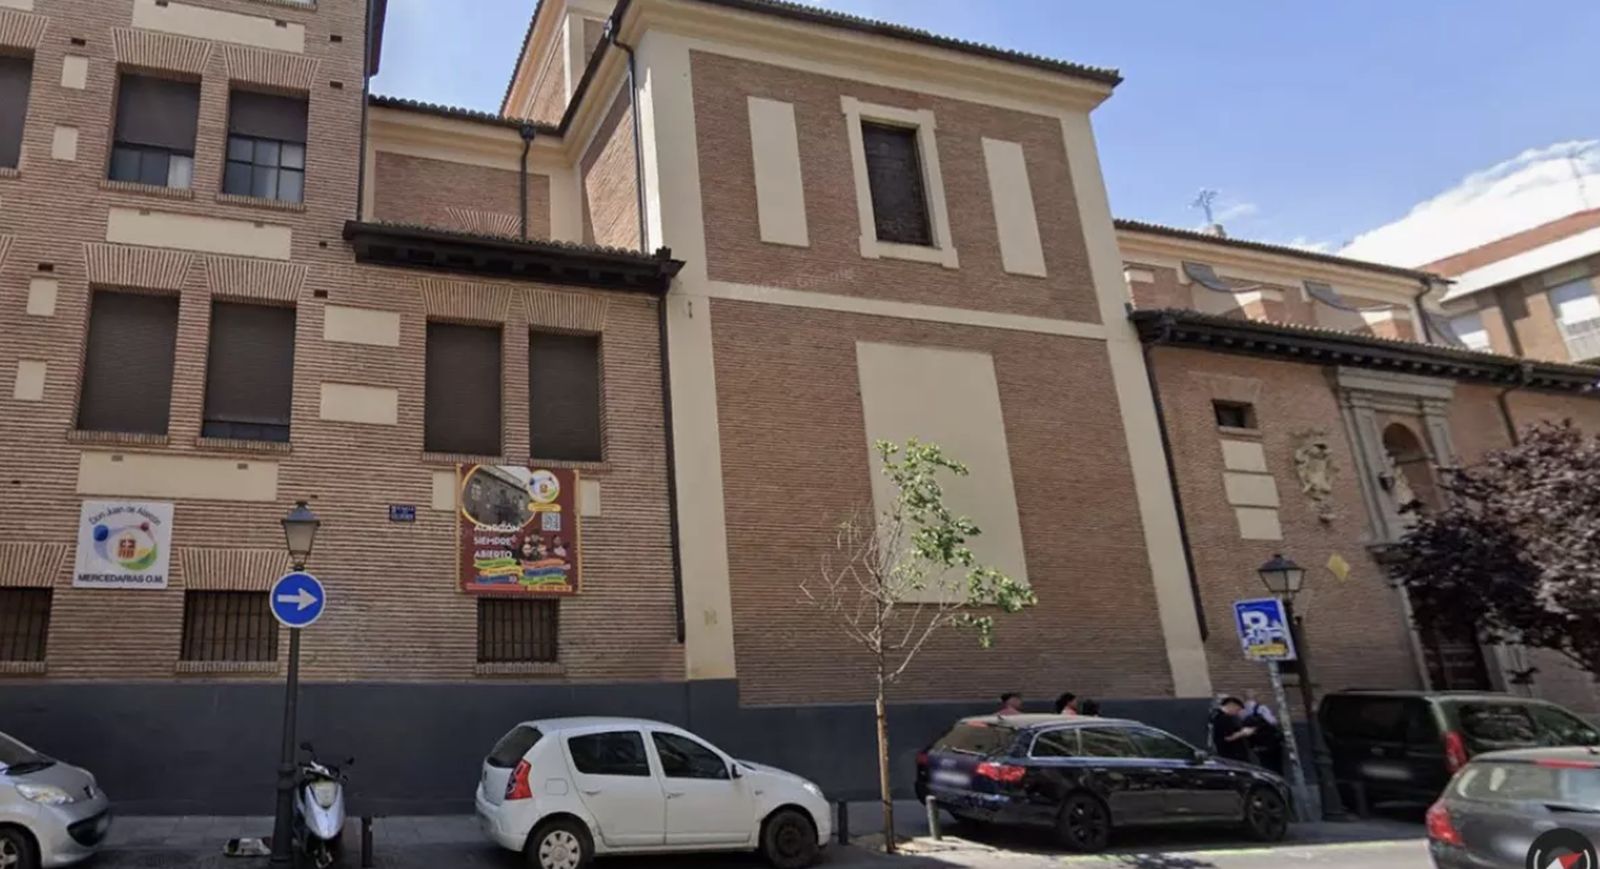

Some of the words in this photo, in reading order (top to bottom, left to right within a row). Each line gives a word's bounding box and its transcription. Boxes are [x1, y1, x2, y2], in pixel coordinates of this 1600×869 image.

[89, 512, 106, 525] Don
[107, 507, 124, 516] Juan
[474, 536, 512, 545] SIEMPRE
[474, 550, 513, 559] ABIERTO
[78, 574, 144, 583] MERCEDARIAS
